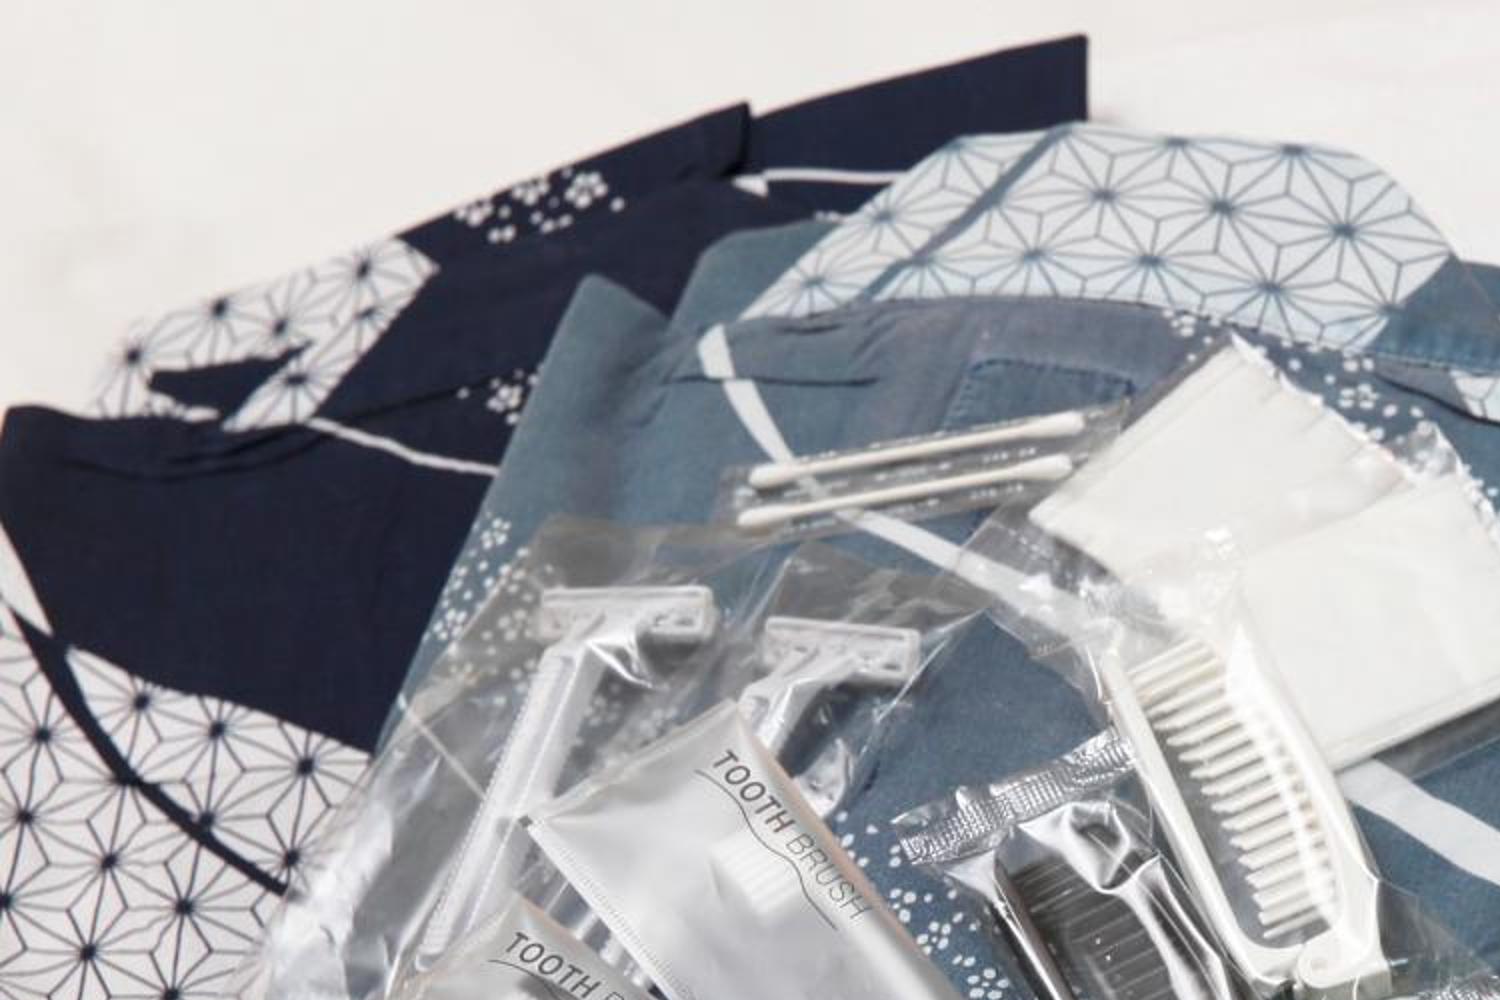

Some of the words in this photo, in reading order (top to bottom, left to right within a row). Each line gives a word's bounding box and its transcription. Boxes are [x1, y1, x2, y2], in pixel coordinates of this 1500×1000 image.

[712, 749, 795, 835] TOOTH
[785, 832, 873, 921] BRUSH
[504, 931, 601, 999] TOOTH
